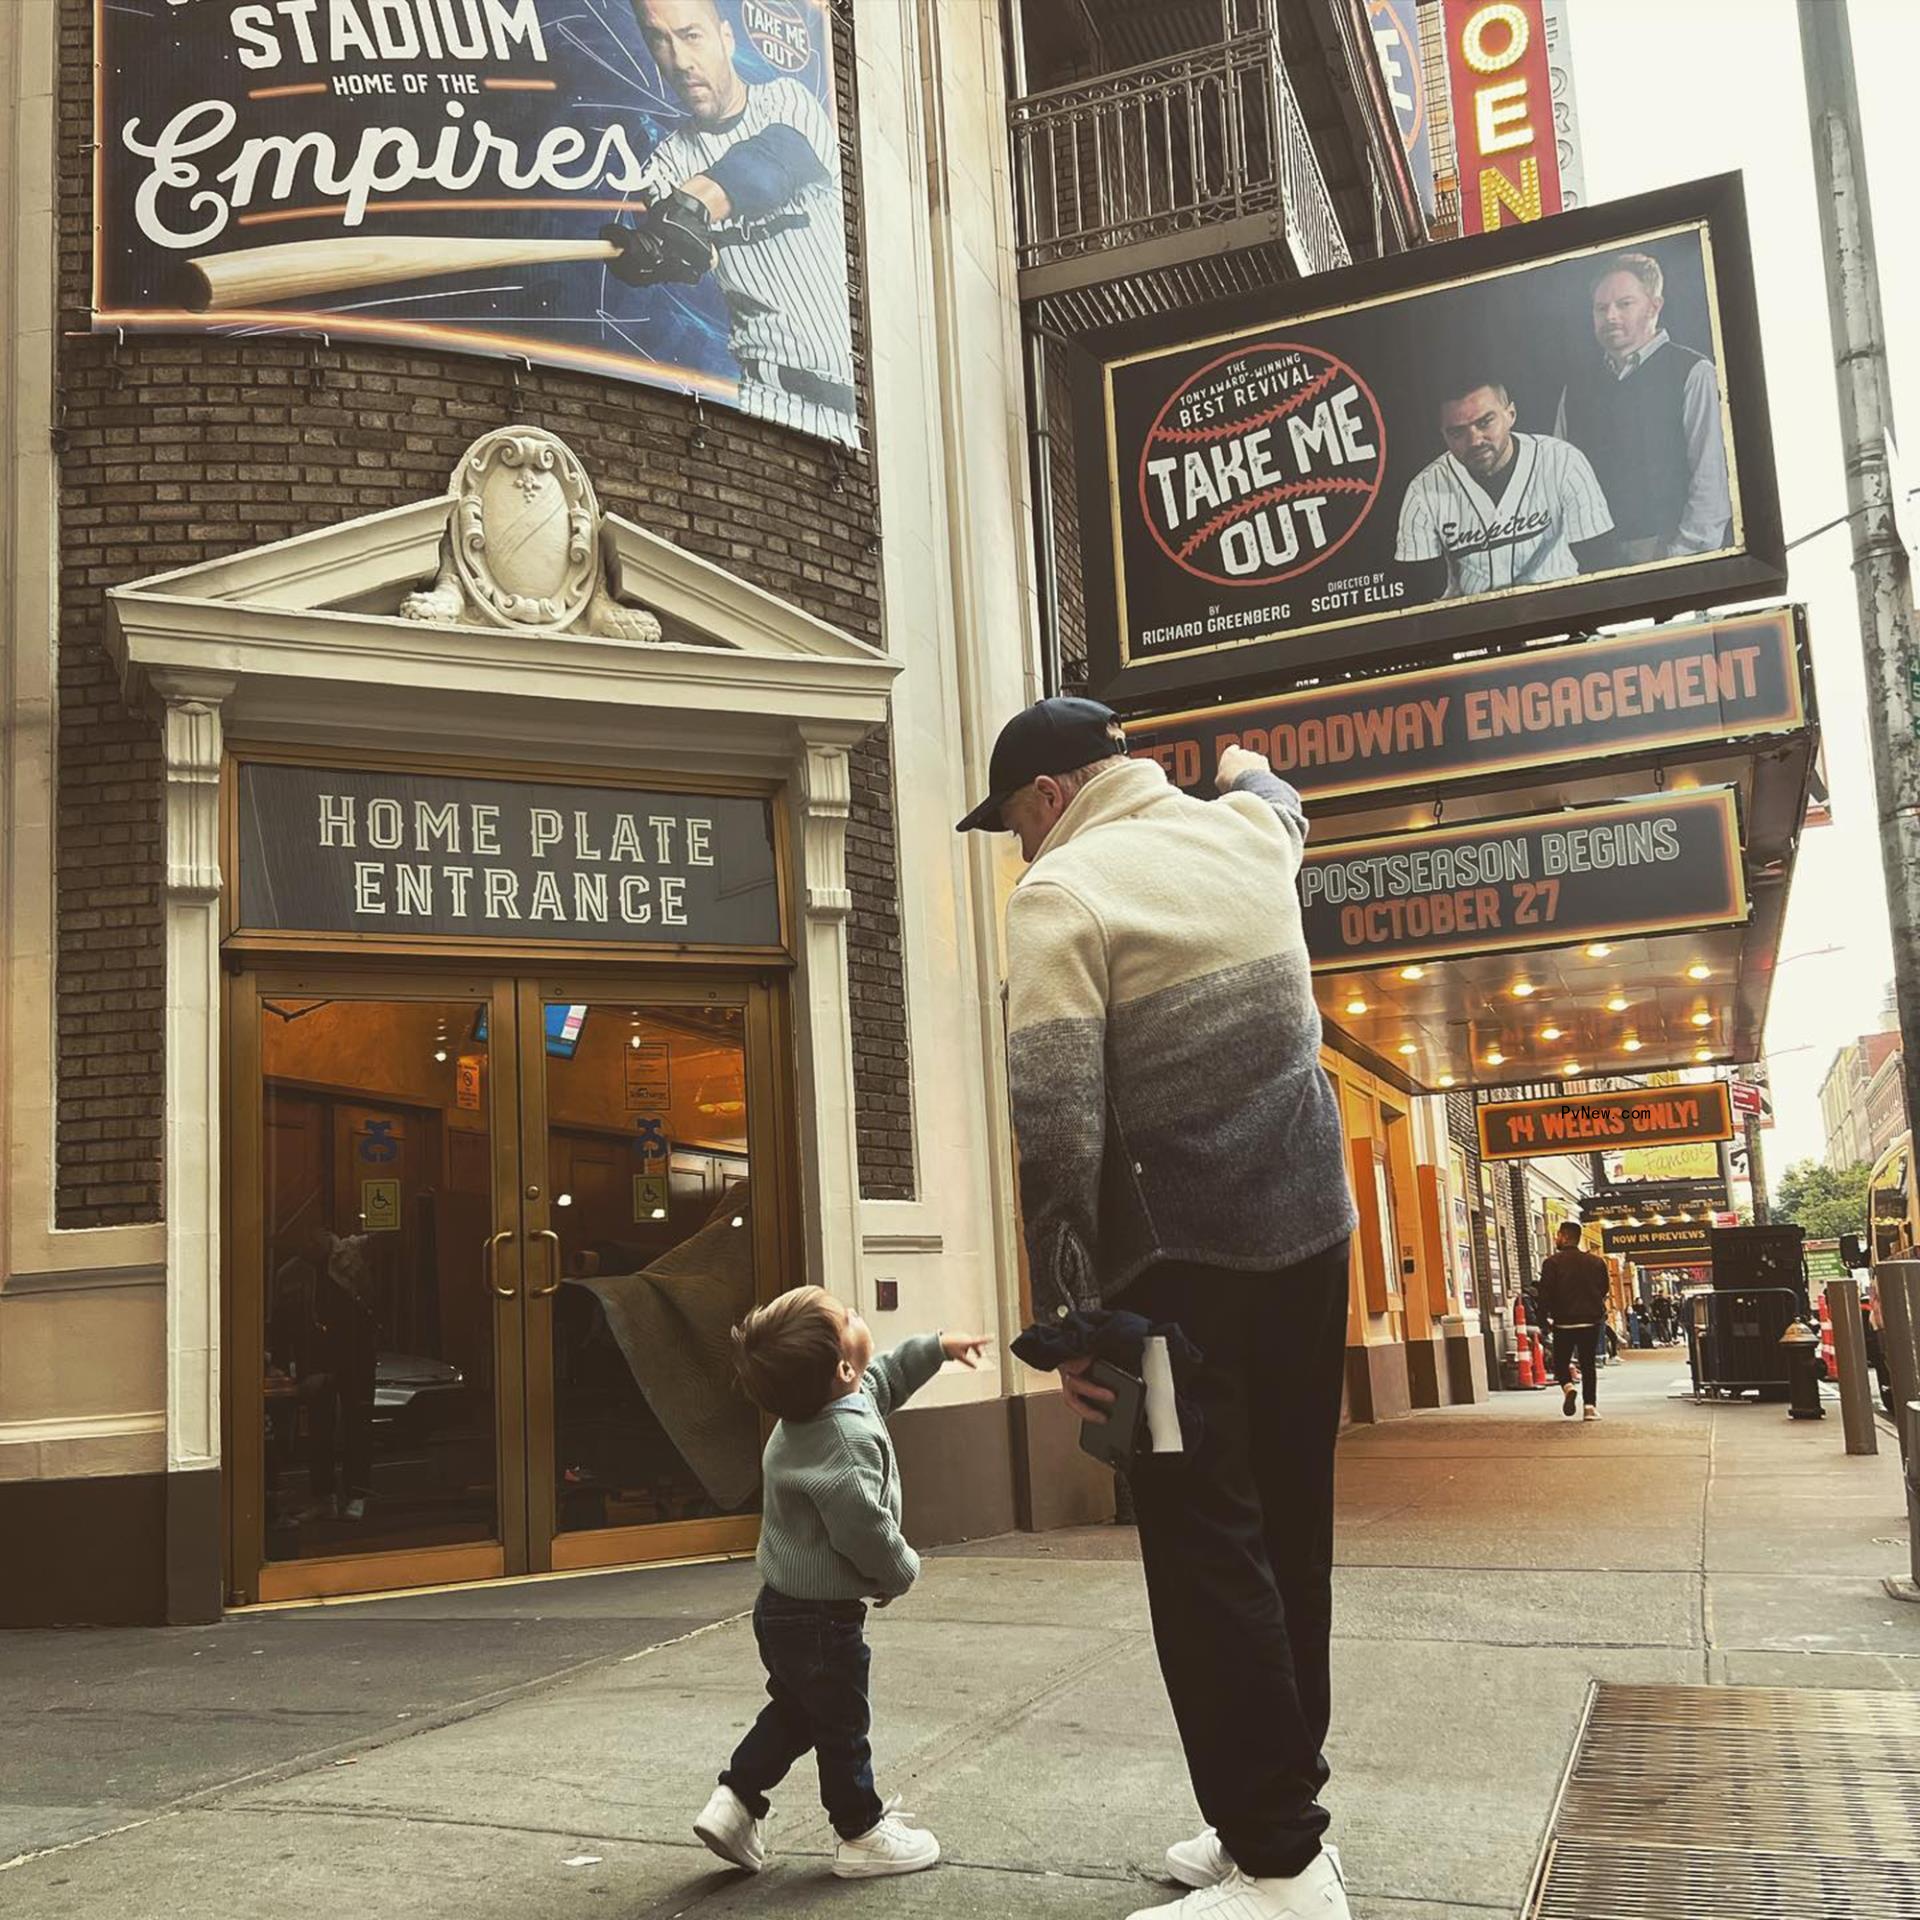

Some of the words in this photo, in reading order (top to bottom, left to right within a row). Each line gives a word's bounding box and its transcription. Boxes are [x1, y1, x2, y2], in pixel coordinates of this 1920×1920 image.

[231, 0, 549, 70] STADIUM
[745, 1, 783, 39] TAKE
[785, 23, 808, 55] ME
[763, 40, 793, 68] OUT
[333, 76, 396, 95] HOME
[404, 75, 430, 93] OF
[438, 74, 479, 94] THE
[122, 99, 652, 249] Empires
[1227, 361, 1247, 376] THE
[1180, 395, 1224, 427] BEST
[1234, 363, 1314, 408] REVIVAL
[1180, 388, 1206, 406] TONY
[1147, 428, 1282, 530] TAKE
[1287, 384, 1376, 474] ME
[1219, 496, 1327, 576] OUT
[1442, 510, 1551, 549] Empires
[1311, 590, 1358, 613] SCOTT
[1364, 582, 1405, 603] ELLIS
[1328, 575, 1370, 593] DIRECTED
[1373, 573, 1385, 585] BY
[1142, 620, 1203, 645] RICHARD
[1208, 604, 1291, 634] GREENBERG
[1209, 604, 1220, 616] BY
[1464, 646, 1760, 741] ENGAGEMENT
[318, 795, 501, 854] HOME
[530, 808, 715, 866] PLATE
[1301, 838, 1530, 907] POSTSEASON
[1541, 818, 1680, 876] BEGINS
[354, 861, 688, 925] ENTRANCE
[1341, 887, 1501, 945] OCTOBER
[1512, 879, 1560, 924] 27
[1506, 1114, 1535, 1143] 14
[1541, 1106, 1626, 1140] WEEKS
[1631, 1099, 1699, 1132] ONLY!
[1612, 1234, 1637, 1245] NOW
[1638, 1232, 1650, 1243] IN
[1651, 1229, 1706, 1241] PREVIEWS
